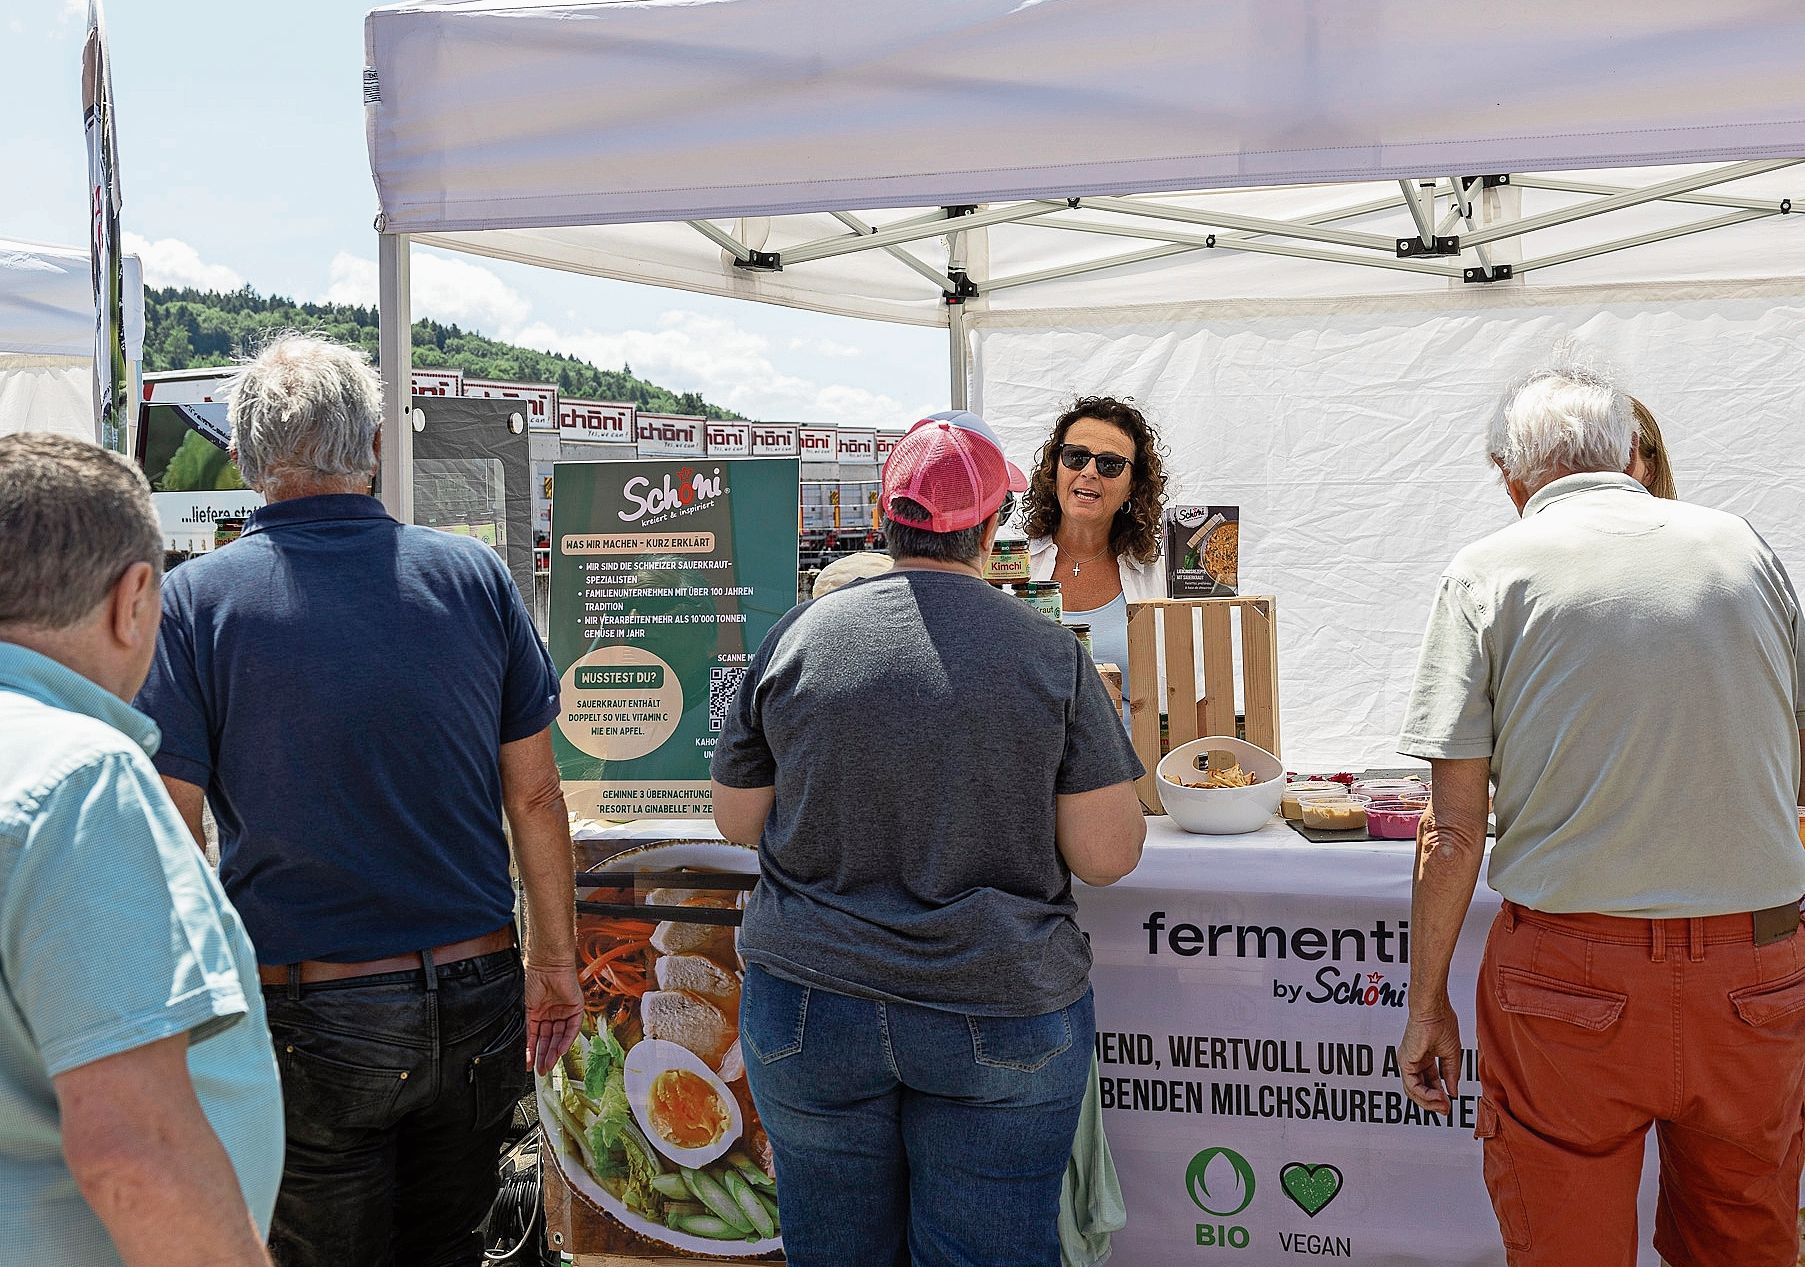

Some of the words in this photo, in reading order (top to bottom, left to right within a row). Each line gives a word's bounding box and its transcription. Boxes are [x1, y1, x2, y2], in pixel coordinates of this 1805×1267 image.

[641, 513, 668, 527] kreiert
[679, 500, 715, 516] inspiriert
[566, 539, 584, 549] WAS
[586, 539, 601, 549] WIR
[603, 538, 638, 549] MACHEN
[646, 537, 670, 548] KURZ
[671, 535, 710, 548] ERKLÄRT
[586, 562, 600, 571] WIR
[601, 562, 619, 571] SIND
[620, 561, 633, 570] DIE
[633, 561, 677, 570] SCHWEIZER
[678, 560, 732, 570] SAUERKRAUT-
[991, 561, 1022, 571] Kimchi
[585, 575, 638, 585] SPEZIALISTEN
[585, 588, 673, 598] FAMILIENUNTERNEHMEN
[674, 588, 688, 597] MIT
[688, 586, 709, 597] ÜBER
[710, 587, 723, 596] 100
[723, 586, 754, 596] JAHREN
[585, 602, 624, 611] TRADITION
[1036, 606, 1054, 614] raut
[584, 616, 598, 625] WIR
[600, 615, 651, 624] VERARBEITEN
[651, 615, 673, 624] MEHR
[674, 614, 689, 623] ALS
[716, 614, 747, 623] TONNEN
[584, 628, 615, 638] GEMÜSE
[616, 629, 625, 638] IM
[625, 628, 645, 638] JAHR
[717, 653, 747, 662] SCANNE
[581, 672, 634, 684] WUSSTEST
[636, 671, 657, 683] DU?
[576, 699, 627, 709] SAUERKRAUT
[628, 698, 661, 708] ENTHÄLT
[568, 713, 601, 722] DOPPELT
[602, 713, 613, 721] SO
[615, 713, 631, 722] VIEL
[632, 713, 662, 721] VITAMIN
[663, 713, 668, 722] C
[591, 727, 604, 735] WIE
[605, 727, 618, 735] EIN
[619, 727, 645, 735] APFEL.
[602, 790, 638, 799] GEWINNE
[639, 790, 645, 798] 3
[632, 804, 643, 813] LA
[692, 804, 700, 813] IN
[702, 804, 713, 813] ZE
[1142, 911, 1409, 964] fermenti
[1273, 979, 1303, 1004] by
[1168, 1034, 1310, 1074] WERTVOLL
[1317, 1041, 1374, 1077] UND
[1099, 1077, 1202, 1113] BENDEN
[1210, 1081, 1477, 1129] MILCHSÄUREBATE
[1195, 1223, 1250, 1248] BIO
[1278, 1231, 1352, 1257] VEGAN
